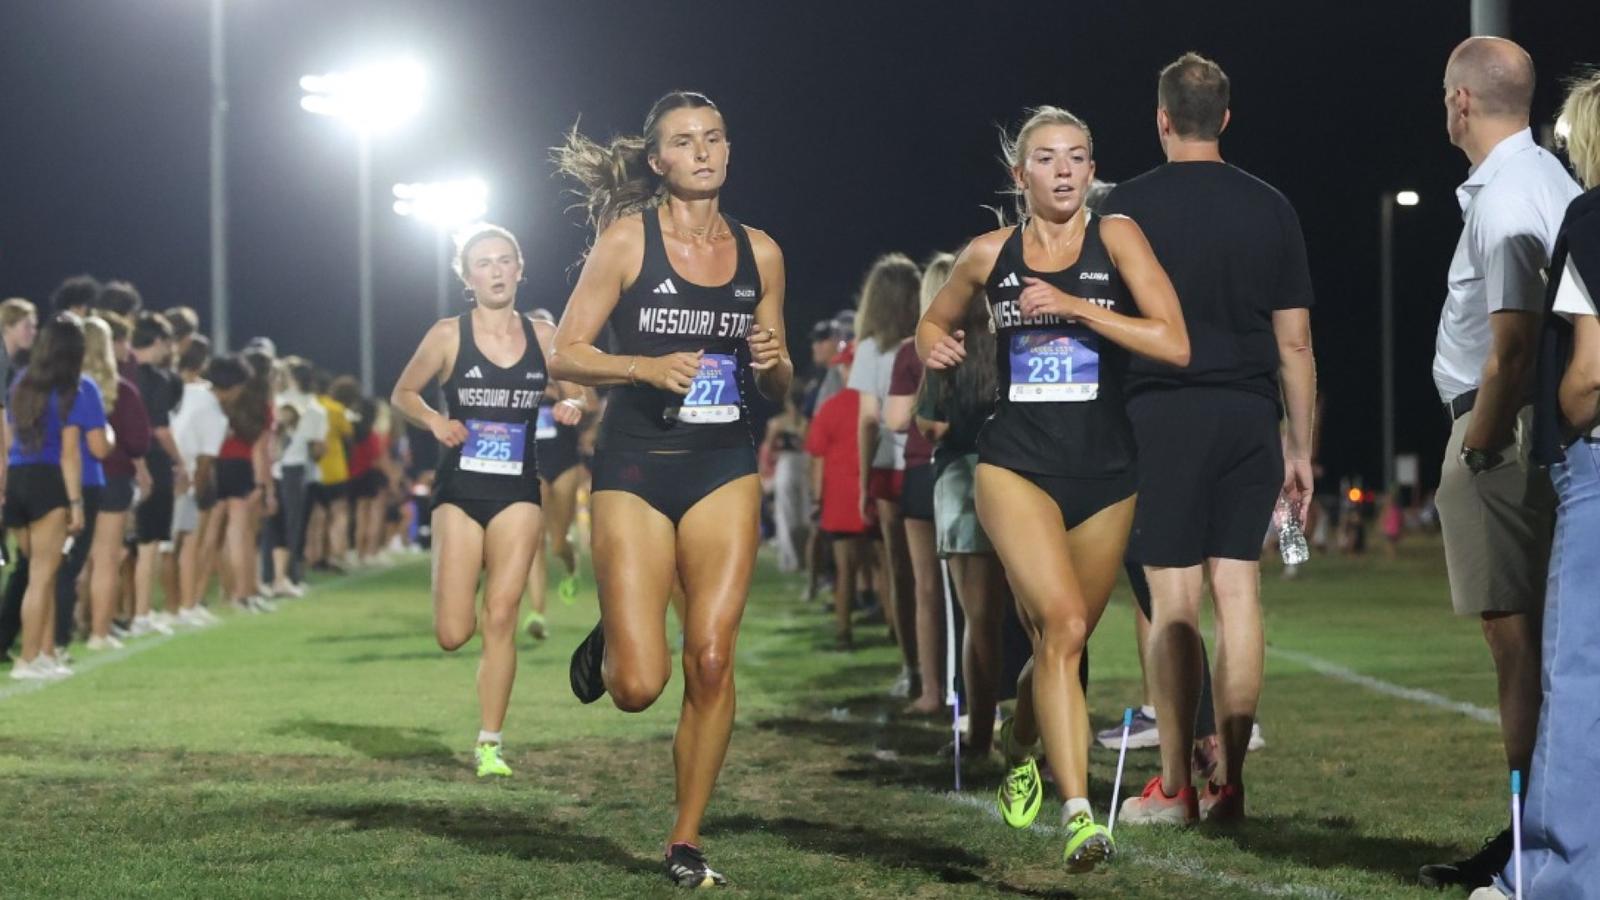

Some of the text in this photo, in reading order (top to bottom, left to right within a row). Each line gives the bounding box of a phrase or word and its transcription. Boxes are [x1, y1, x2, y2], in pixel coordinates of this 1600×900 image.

[638, 307, 715, 335] MISSOURI
[993, 300, 1060, 328] MISS
[1028, 356, 1073, 383] 231
[457, 388, 510, 408] MISSOURI
[683, 380, 726, 405] 227
[475, 439, 512, 461] 225
